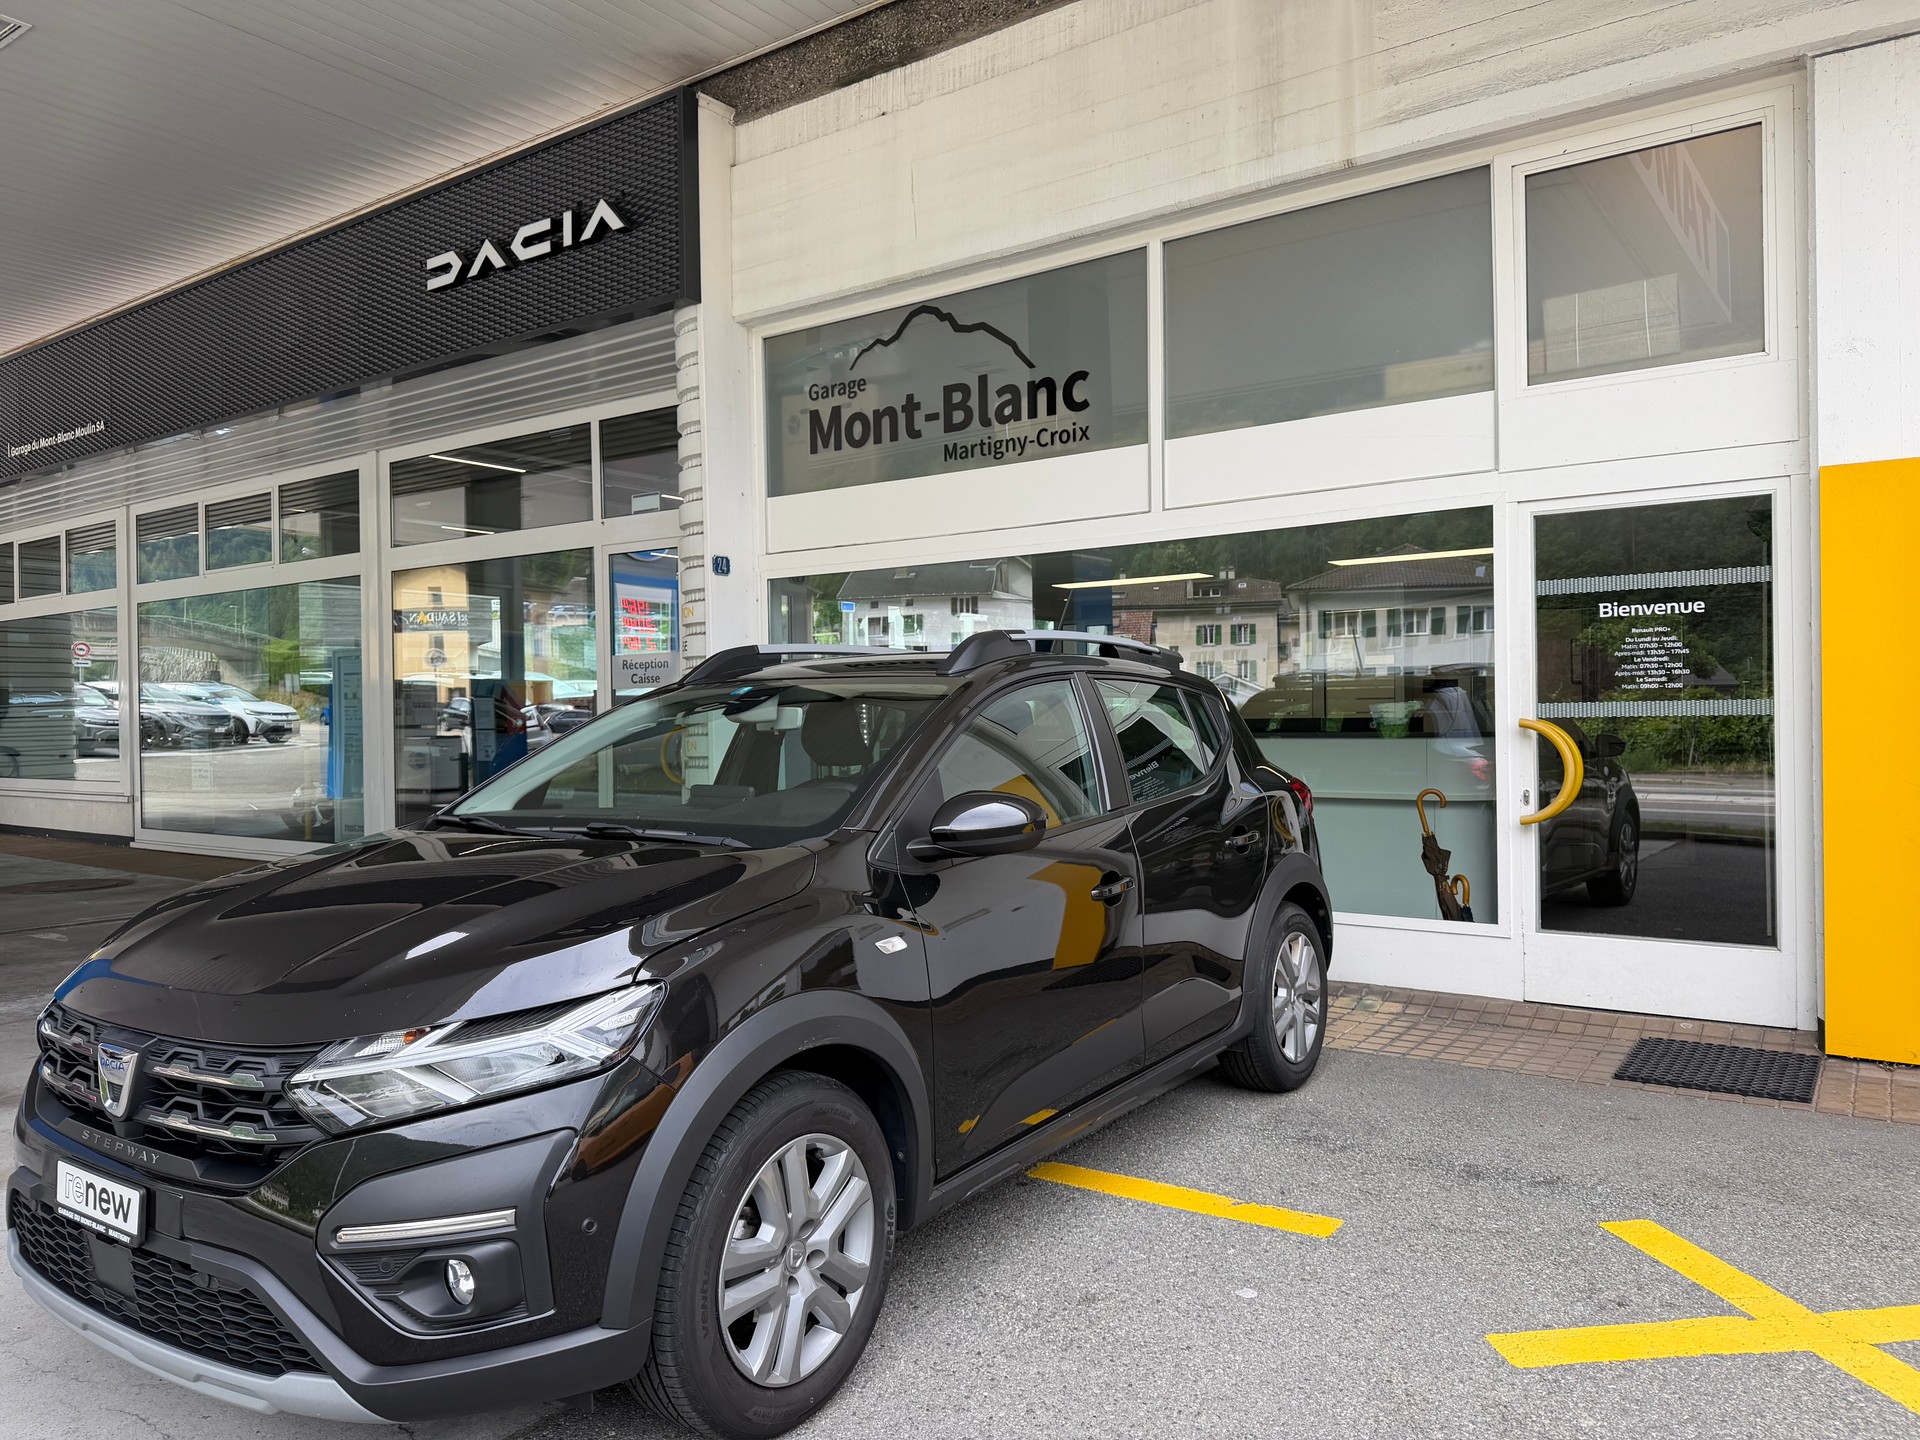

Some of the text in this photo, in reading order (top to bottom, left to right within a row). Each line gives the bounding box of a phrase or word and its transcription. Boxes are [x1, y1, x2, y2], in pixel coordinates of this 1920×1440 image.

[425, 198, 627, 292] DACIA
[808, 377, 867, 401] Garage
[808, 369, 1091, 455] Mont-Blanc
[10, 420, 105, 457] Garage du Mont-Blanc Moulin SA
[943, 421, 1090, 463] Martigny-Croix
[717, 557, 728, 573] 24
[1598, 600, 1706, 618] Bienvenue
[622, 658, 669, 672] Réception
[630, 673, 661, 684] Caisse
[608, 1014, 634, 1027] DACIA
[100, 1056, 126, 1073] DACIA
[81, 1128, 162, 1165] STEPWAY
[64, 1171, 132, 1224] renew
[57, 1206, 74, 1220] GARAGE
